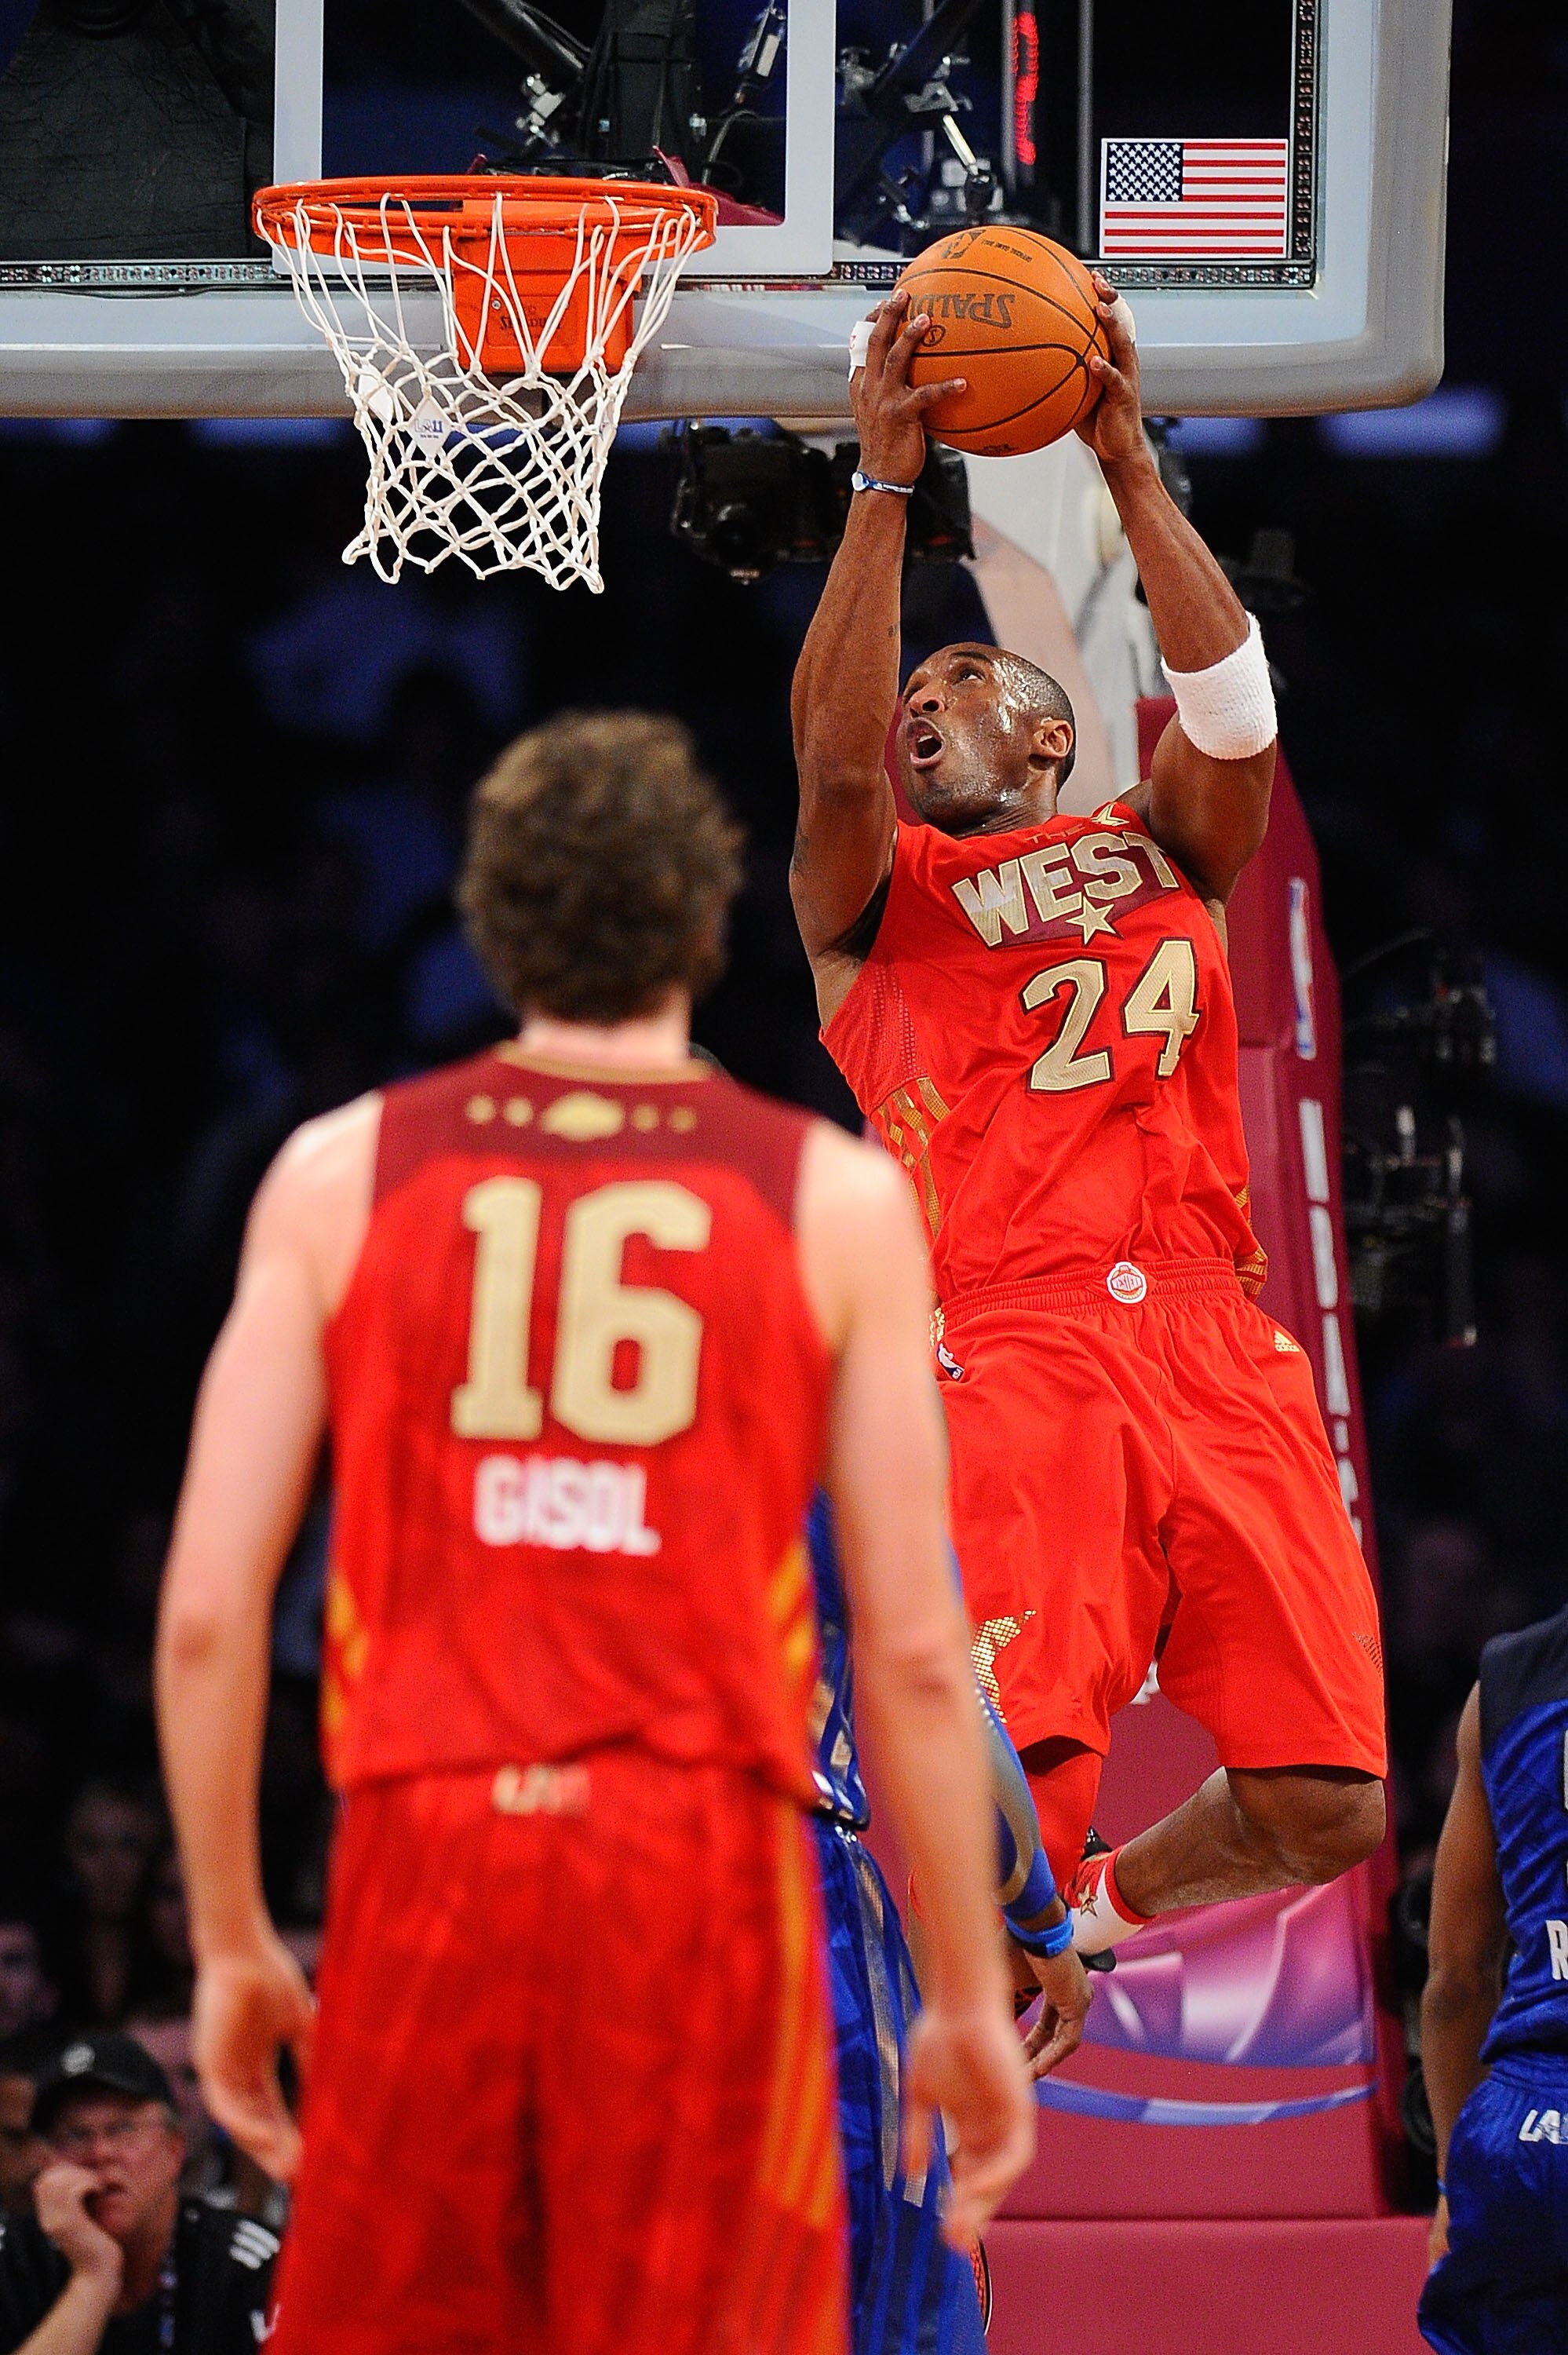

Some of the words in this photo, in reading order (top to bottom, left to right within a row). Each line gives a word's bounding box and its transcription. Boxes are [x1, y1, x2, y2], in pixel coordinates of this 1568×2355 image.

[909, 293, 1016, 329] SPALDI
[950, 831, 1180, 947] WEST
[1025, 824, 1086, 844] THE
[1018, 937, 1203, 1094] 24
[451, 1175, 713, 1446] 16
